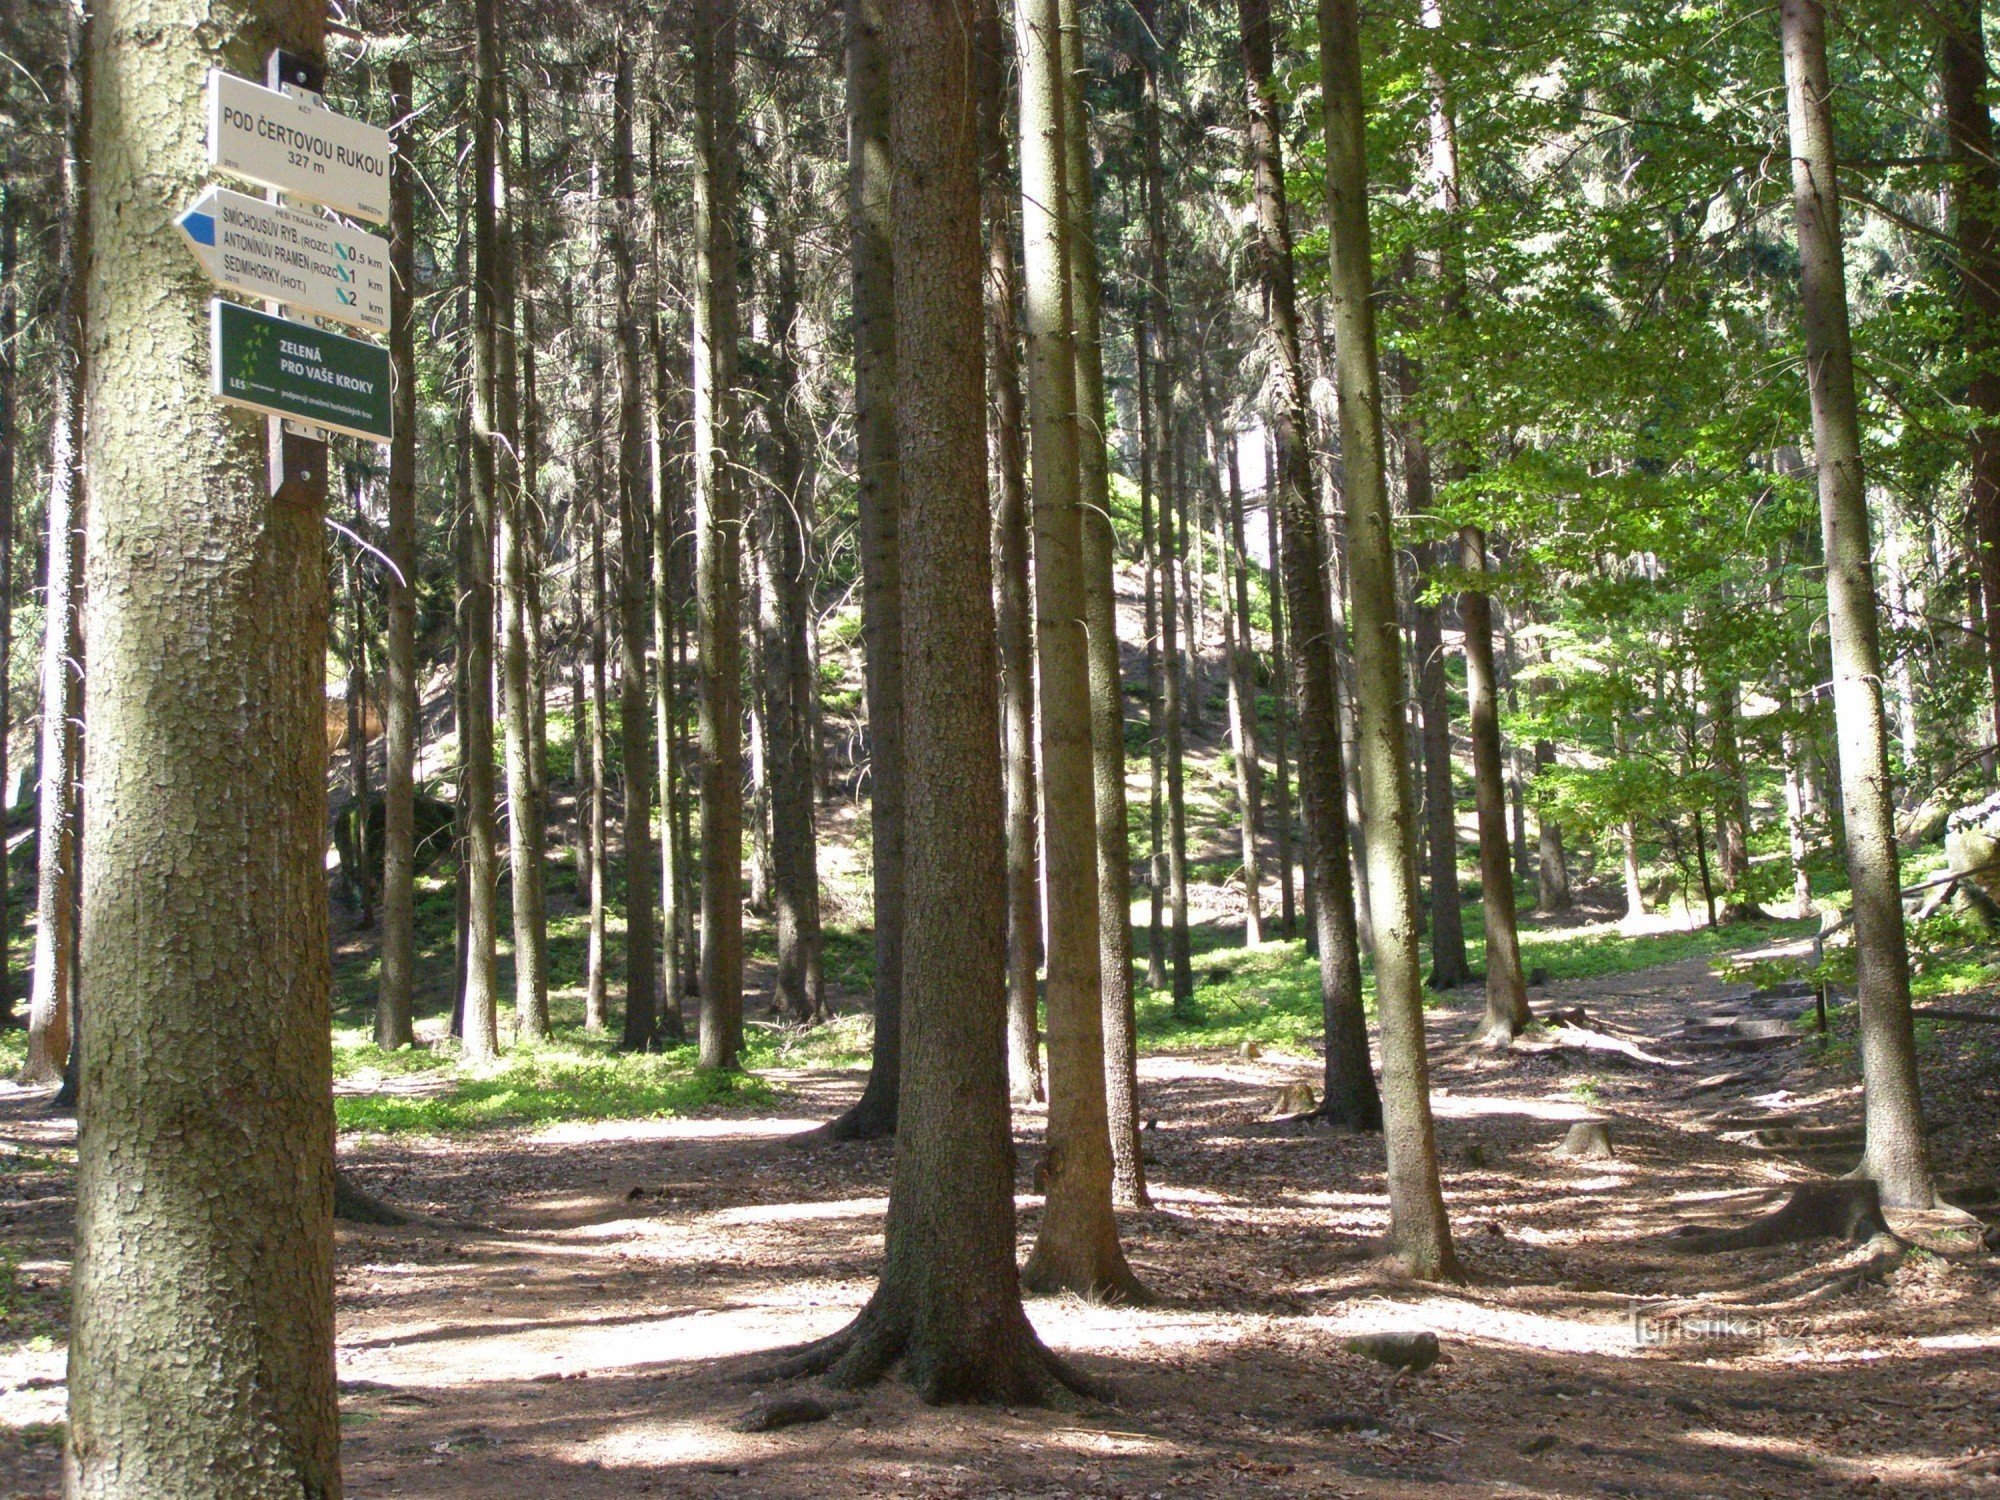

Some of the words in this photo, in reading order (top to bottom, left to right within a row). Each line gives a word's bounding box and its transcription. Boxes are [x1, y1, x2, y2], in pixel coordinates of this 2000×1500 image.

[224, 107, 253, 132] POD
[258, 115, 333, 159] ČERTOVOU
[336, 146, 384, 177] RUKOU
[288, 151, 309, 168] 327
[313, 163, 325, 174] m
[223, 206, 279, 238] SMÍCHOUSŮV
[281, 223, 301, 244] RYB.
[367, 254, 383, 269] km
[292, 215, 313, 228] TRASA
[224, 230, 273, 259] ANTONÍNŮV
[274, 247, 310, 270] PRAMEN
[349, 269, 357, 284] 1
[368, 279, 383, 292] km
[224, 253, 280, 284] SEDMIHORKY
[280, 274, 307, 294] (HOT.)
[349, 291, 357, 306] 2
[368, 301, 384, 315] km
[280, 339, 322, 363] ZELENÁ
[281, 358, 305, 377] PRO
[305, 366, 334, 385] VAŠE
[336, 373, 374, 395] KROKY
